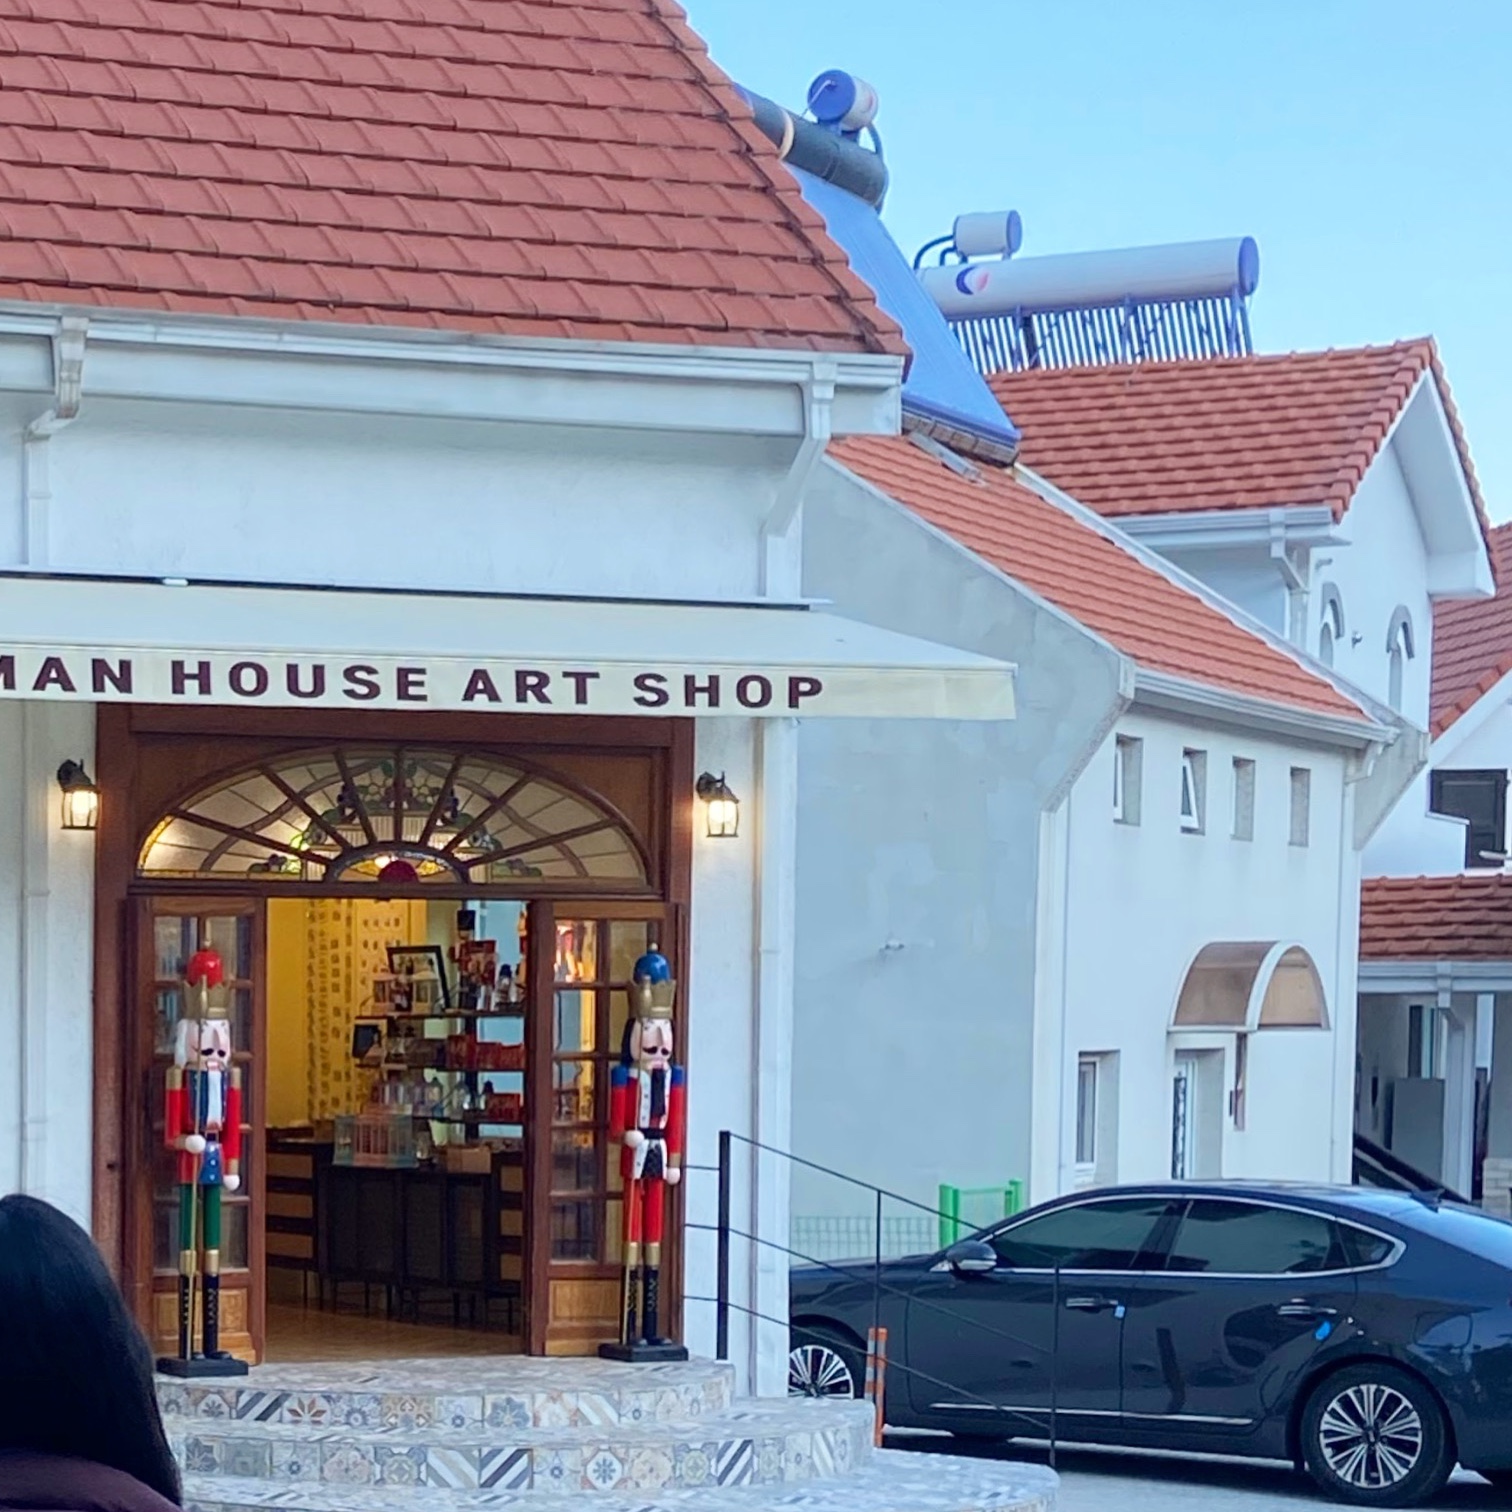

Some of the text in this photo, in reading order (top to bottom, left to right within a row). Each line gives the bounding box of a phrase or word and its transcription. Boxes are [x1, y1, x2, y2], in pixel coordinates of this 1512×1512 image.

[171, 660, 430, 703] HOUSE
[461, 668, 601, 706] ART
[633, 672, 824, 710] SHOP
